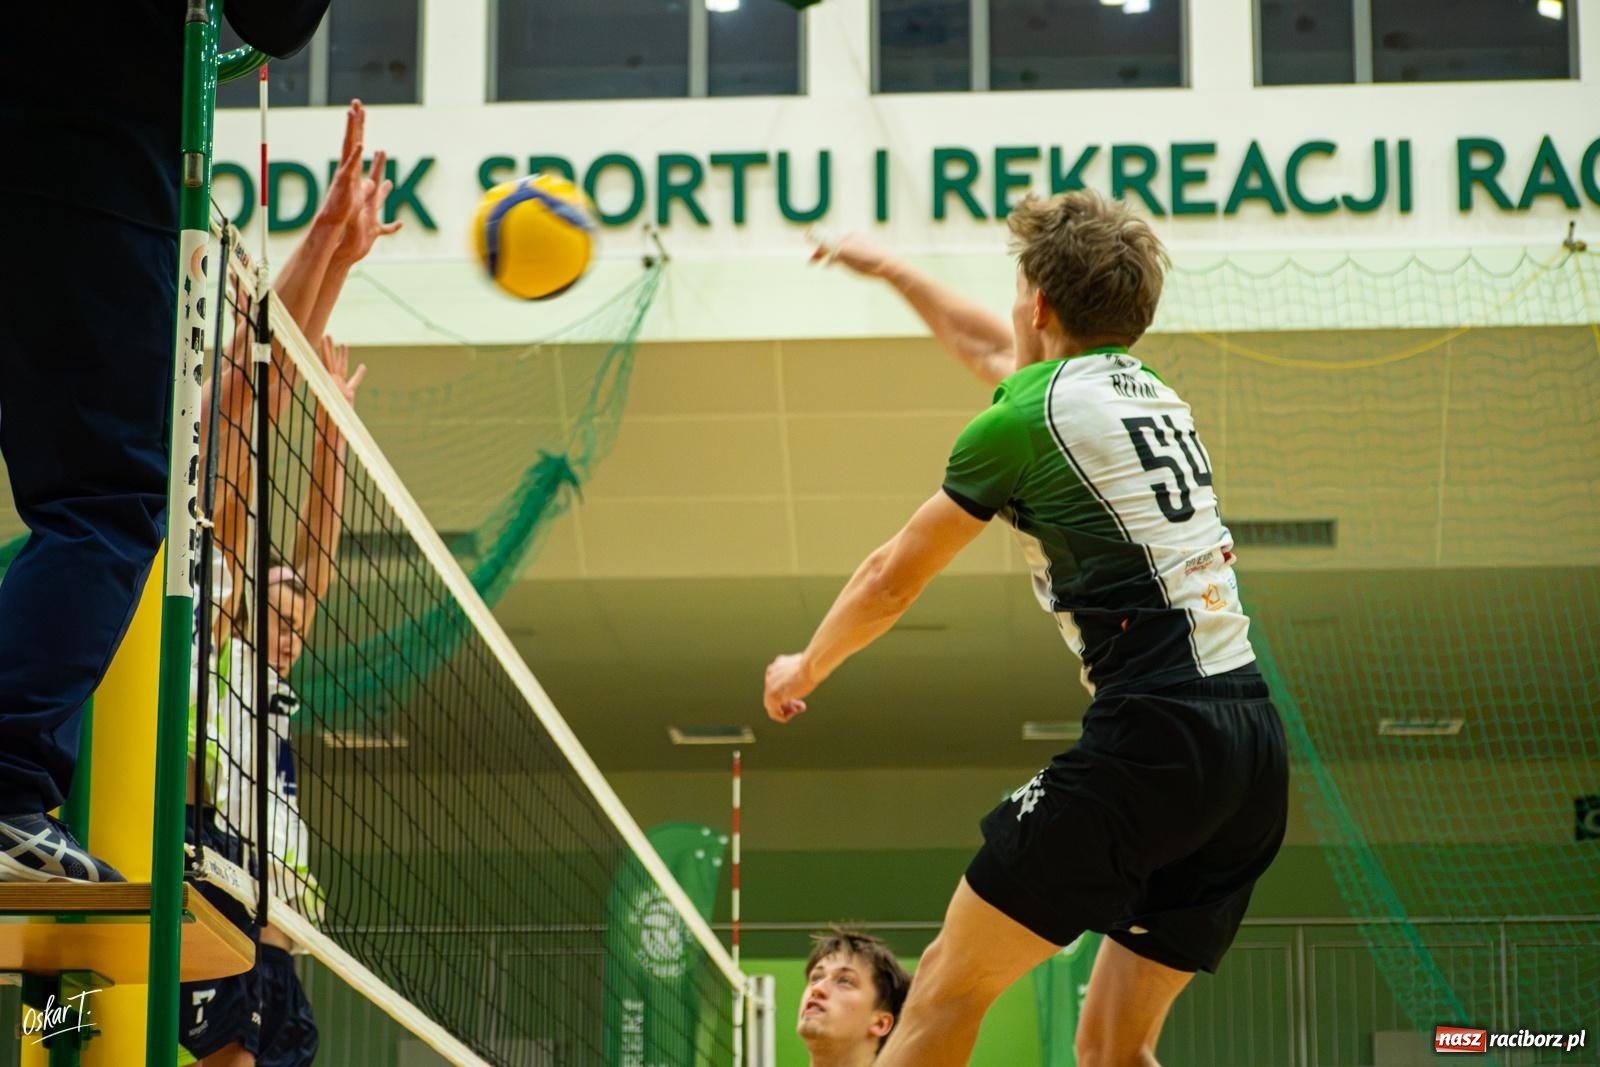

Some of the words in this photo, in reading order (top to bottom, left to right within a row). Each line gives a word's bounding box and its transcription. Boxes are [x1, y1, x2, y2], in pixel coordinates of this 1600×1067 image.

[874, 149, 889, 222] I
[932, 139, 1412, 221] REKREACJI
[192, 988, 217, 1024] 7
